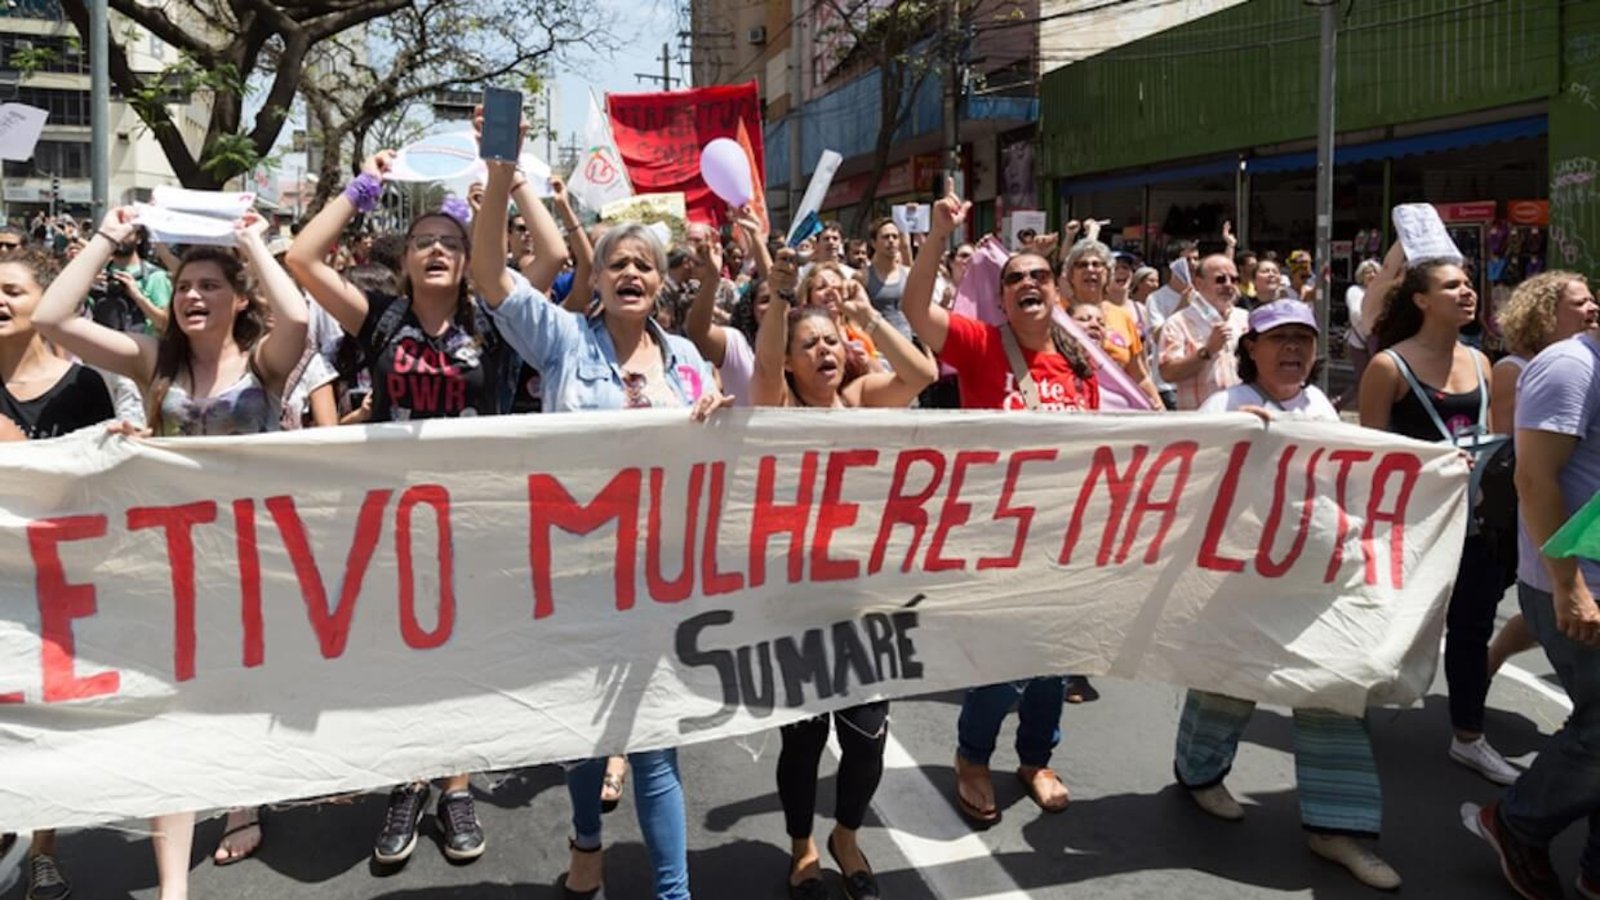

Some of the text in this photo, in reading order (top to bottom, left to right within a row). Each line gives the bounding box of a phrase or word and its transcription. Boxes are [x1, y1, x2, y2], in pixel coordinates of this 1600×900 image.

[386, 371, 468, 413] PWR
[0, 440, 1423, 705] ETIVO MULHERES NA LUTA
[675, 593, 927, 735] SUMARÉ
